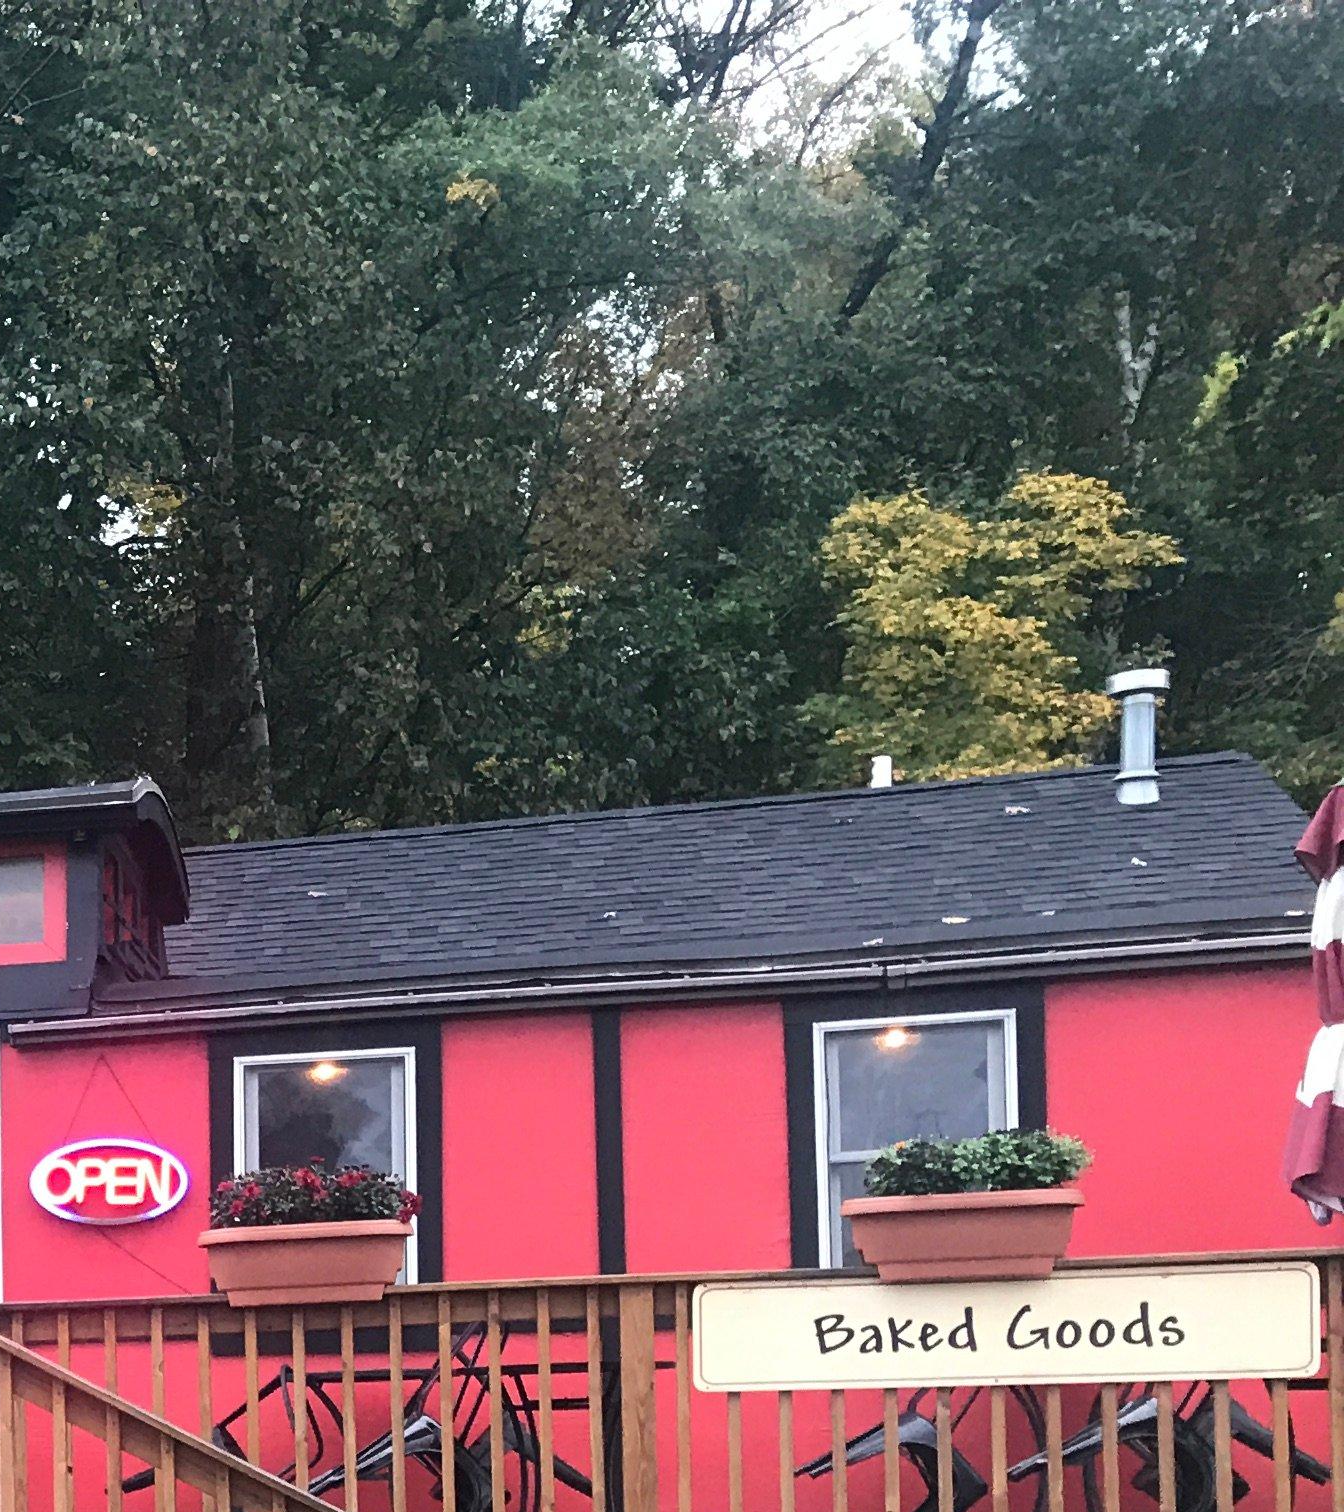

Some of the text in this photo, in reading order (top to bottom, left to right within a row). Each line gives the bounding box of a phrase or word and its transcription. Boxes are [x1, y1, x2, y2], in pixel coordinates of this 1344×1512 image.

[39, 1157, 171, 1206] OPEN
[814, 1302, 1187, 1354] Baked Goods
